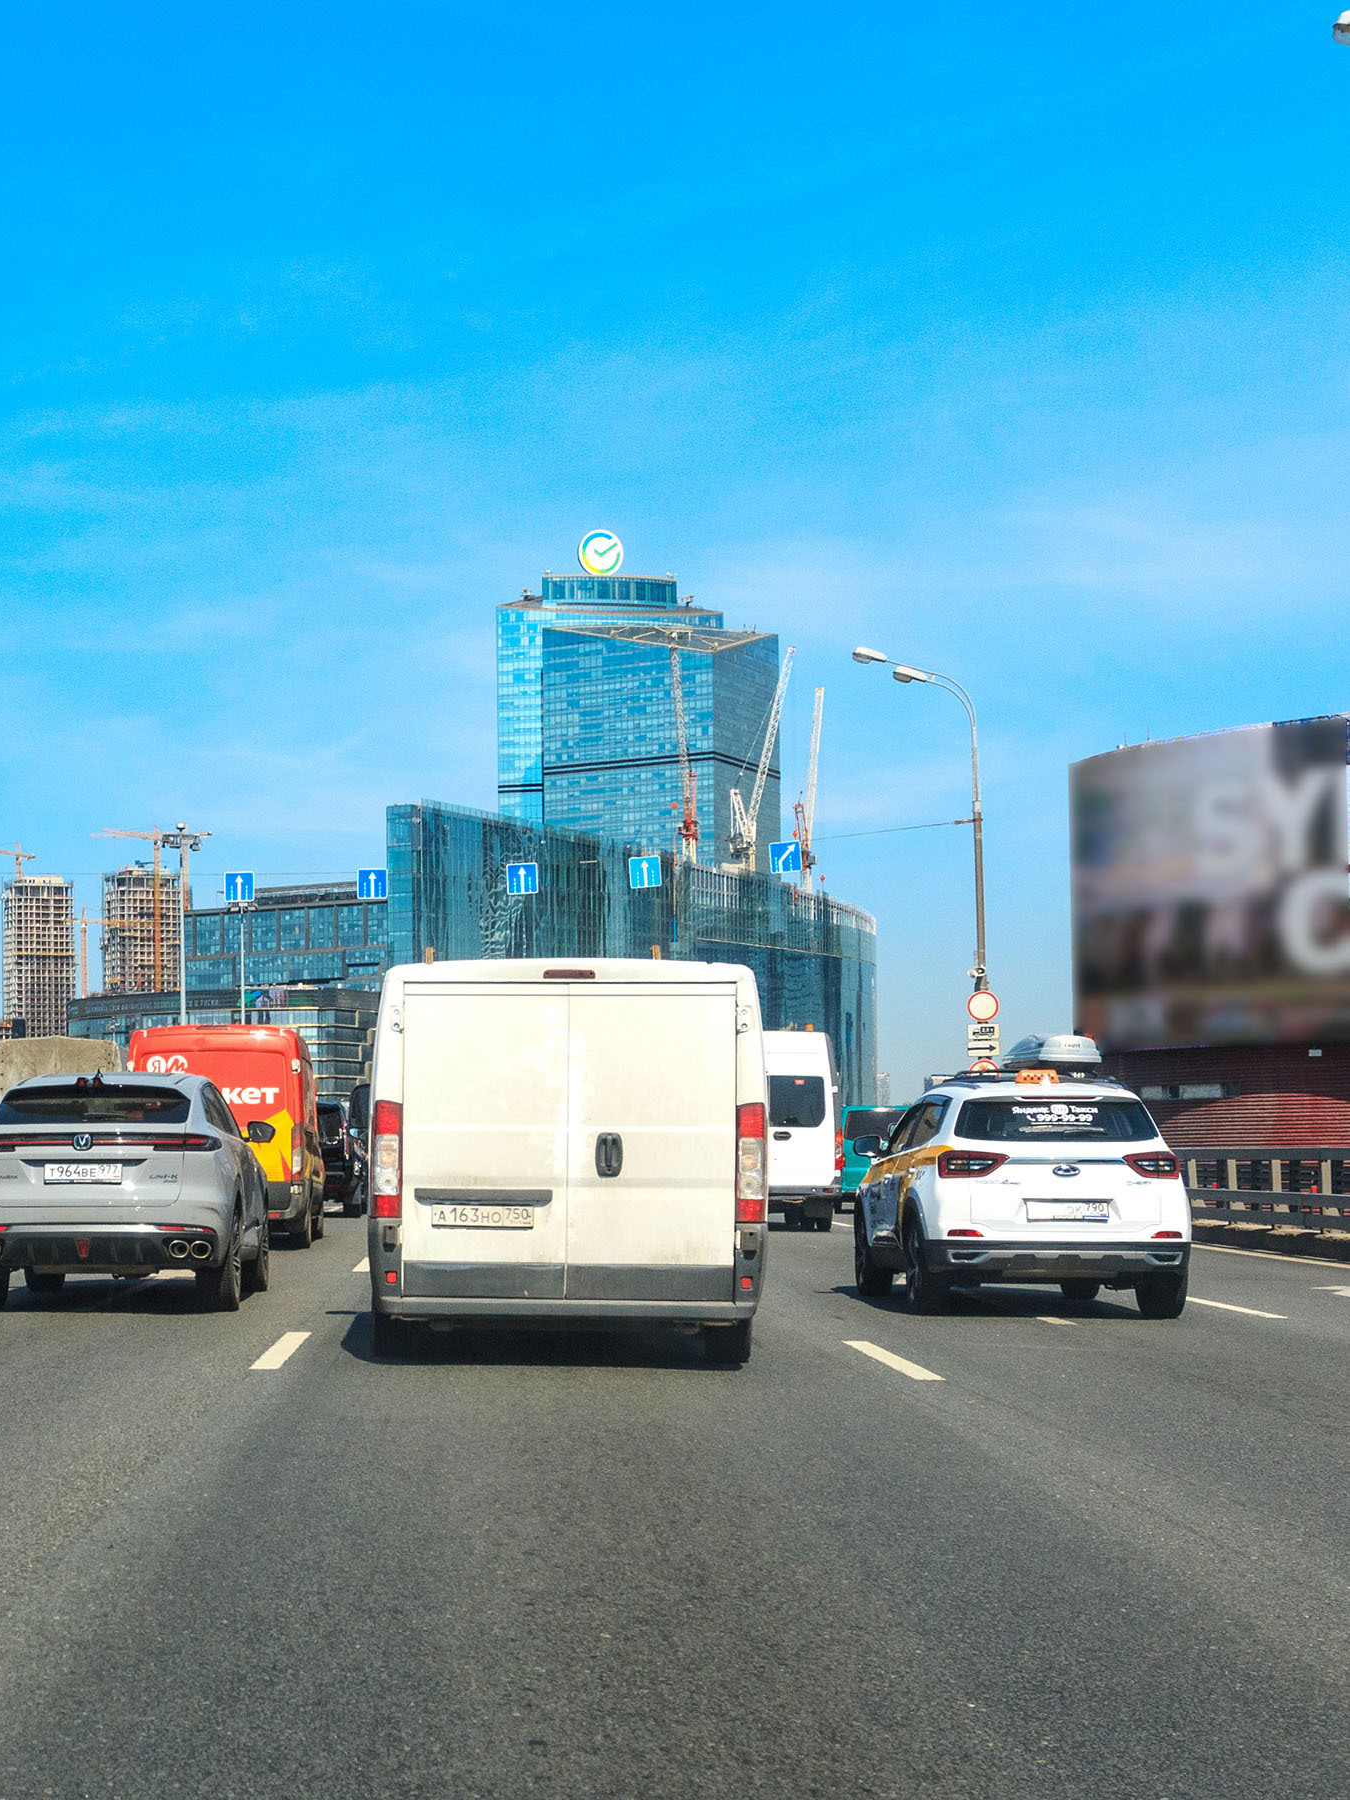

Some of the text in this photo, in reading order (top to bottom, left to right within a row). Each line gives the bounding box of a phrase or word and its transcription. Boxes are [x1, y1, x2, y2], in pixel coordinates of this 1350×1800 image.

[1012, 1106, 1050, 1114] Яндекс
[1070, 1105, 1099, 1114] Такси
[50, 1164, 118, 1178] Т964ВЕ 977
[1085, 1202, 1105, 1213] 790
[438, 1207, 529, 1224] А163НО 750
